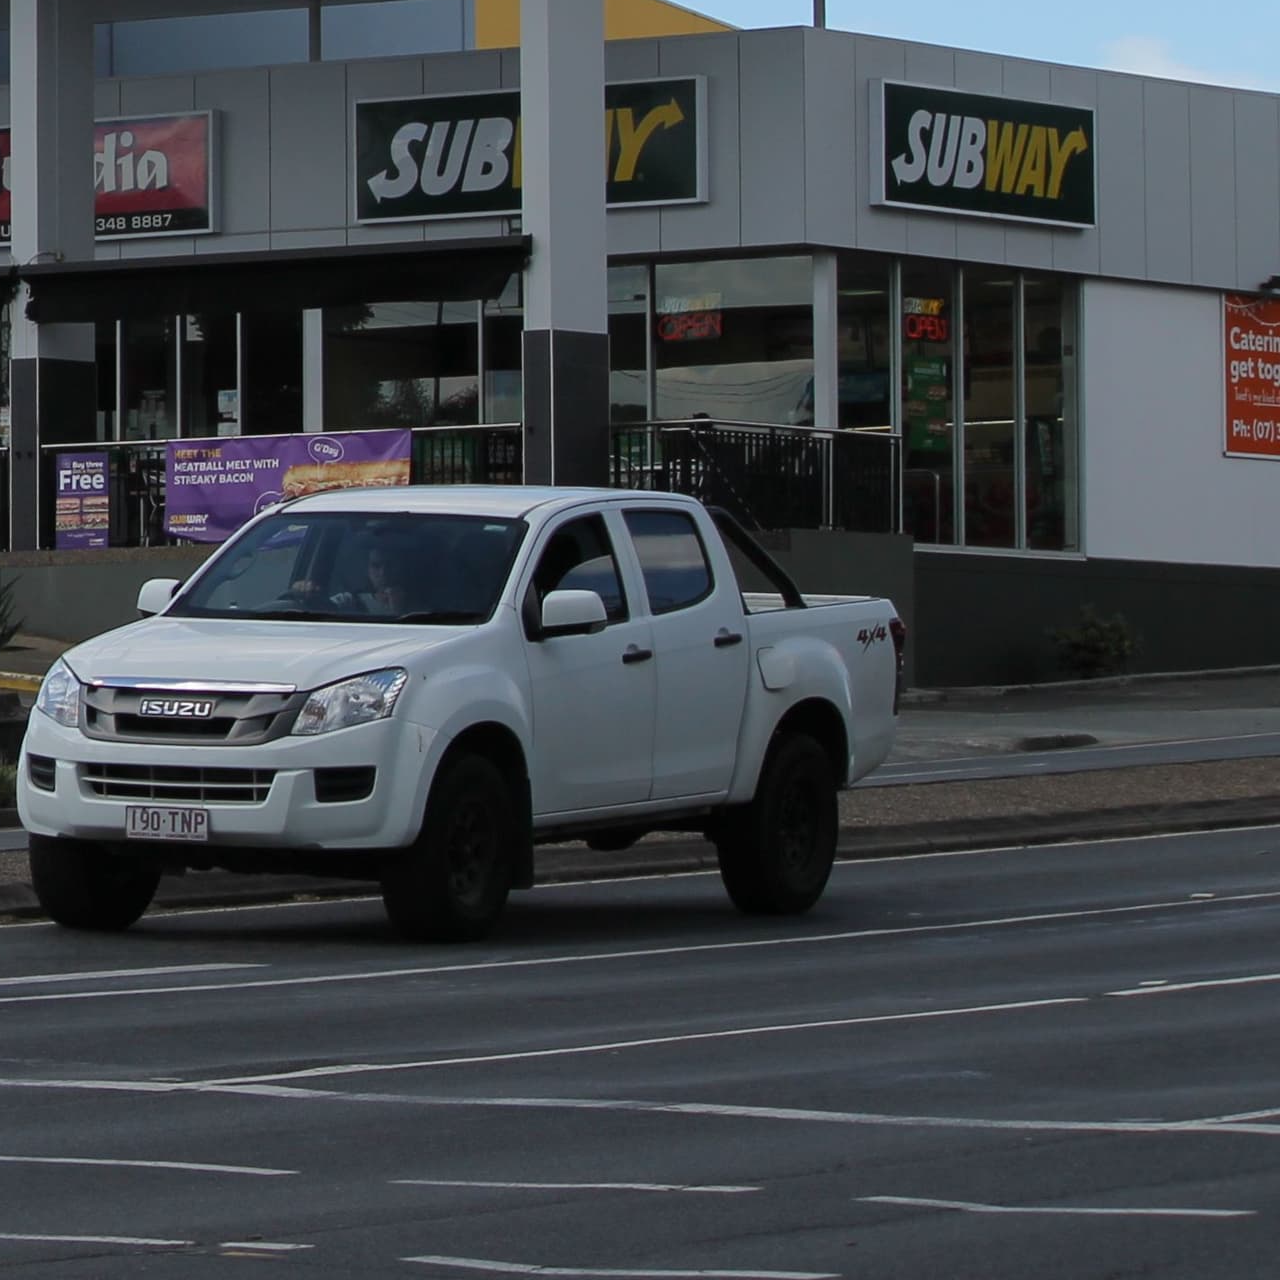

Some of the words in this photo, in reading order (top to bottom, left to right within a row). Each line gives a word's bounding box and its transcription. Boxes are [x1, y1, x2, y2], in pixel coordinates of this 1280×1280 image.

[367, 96, 685, 204] SUBY
[891, 109, 1088, 200] SUBWAY
[94, 131, 169, 194] dia
[95, 217, 127, 232] 348
[131, 214, 172, 229] 8887
[1230, 357, 1254, 383] get
[1232, 419, 1251, 437] Ph:
[1252, 418, 1274, 442] (07)
[202, 448, 222, 458] THE
[174, 461, 224, 472] MEATBALL
[226, 460, 253, 471] MELT
[254, 458, 280, 469] WITH
[59, 470, 105, 491] Free
[174, 474, 217, 485] STREAKY
[219, 472, 254, 484] BACON
[169, 514, 209, 525] SUBWAY
[141, 700, 211, 716] ISUZU
